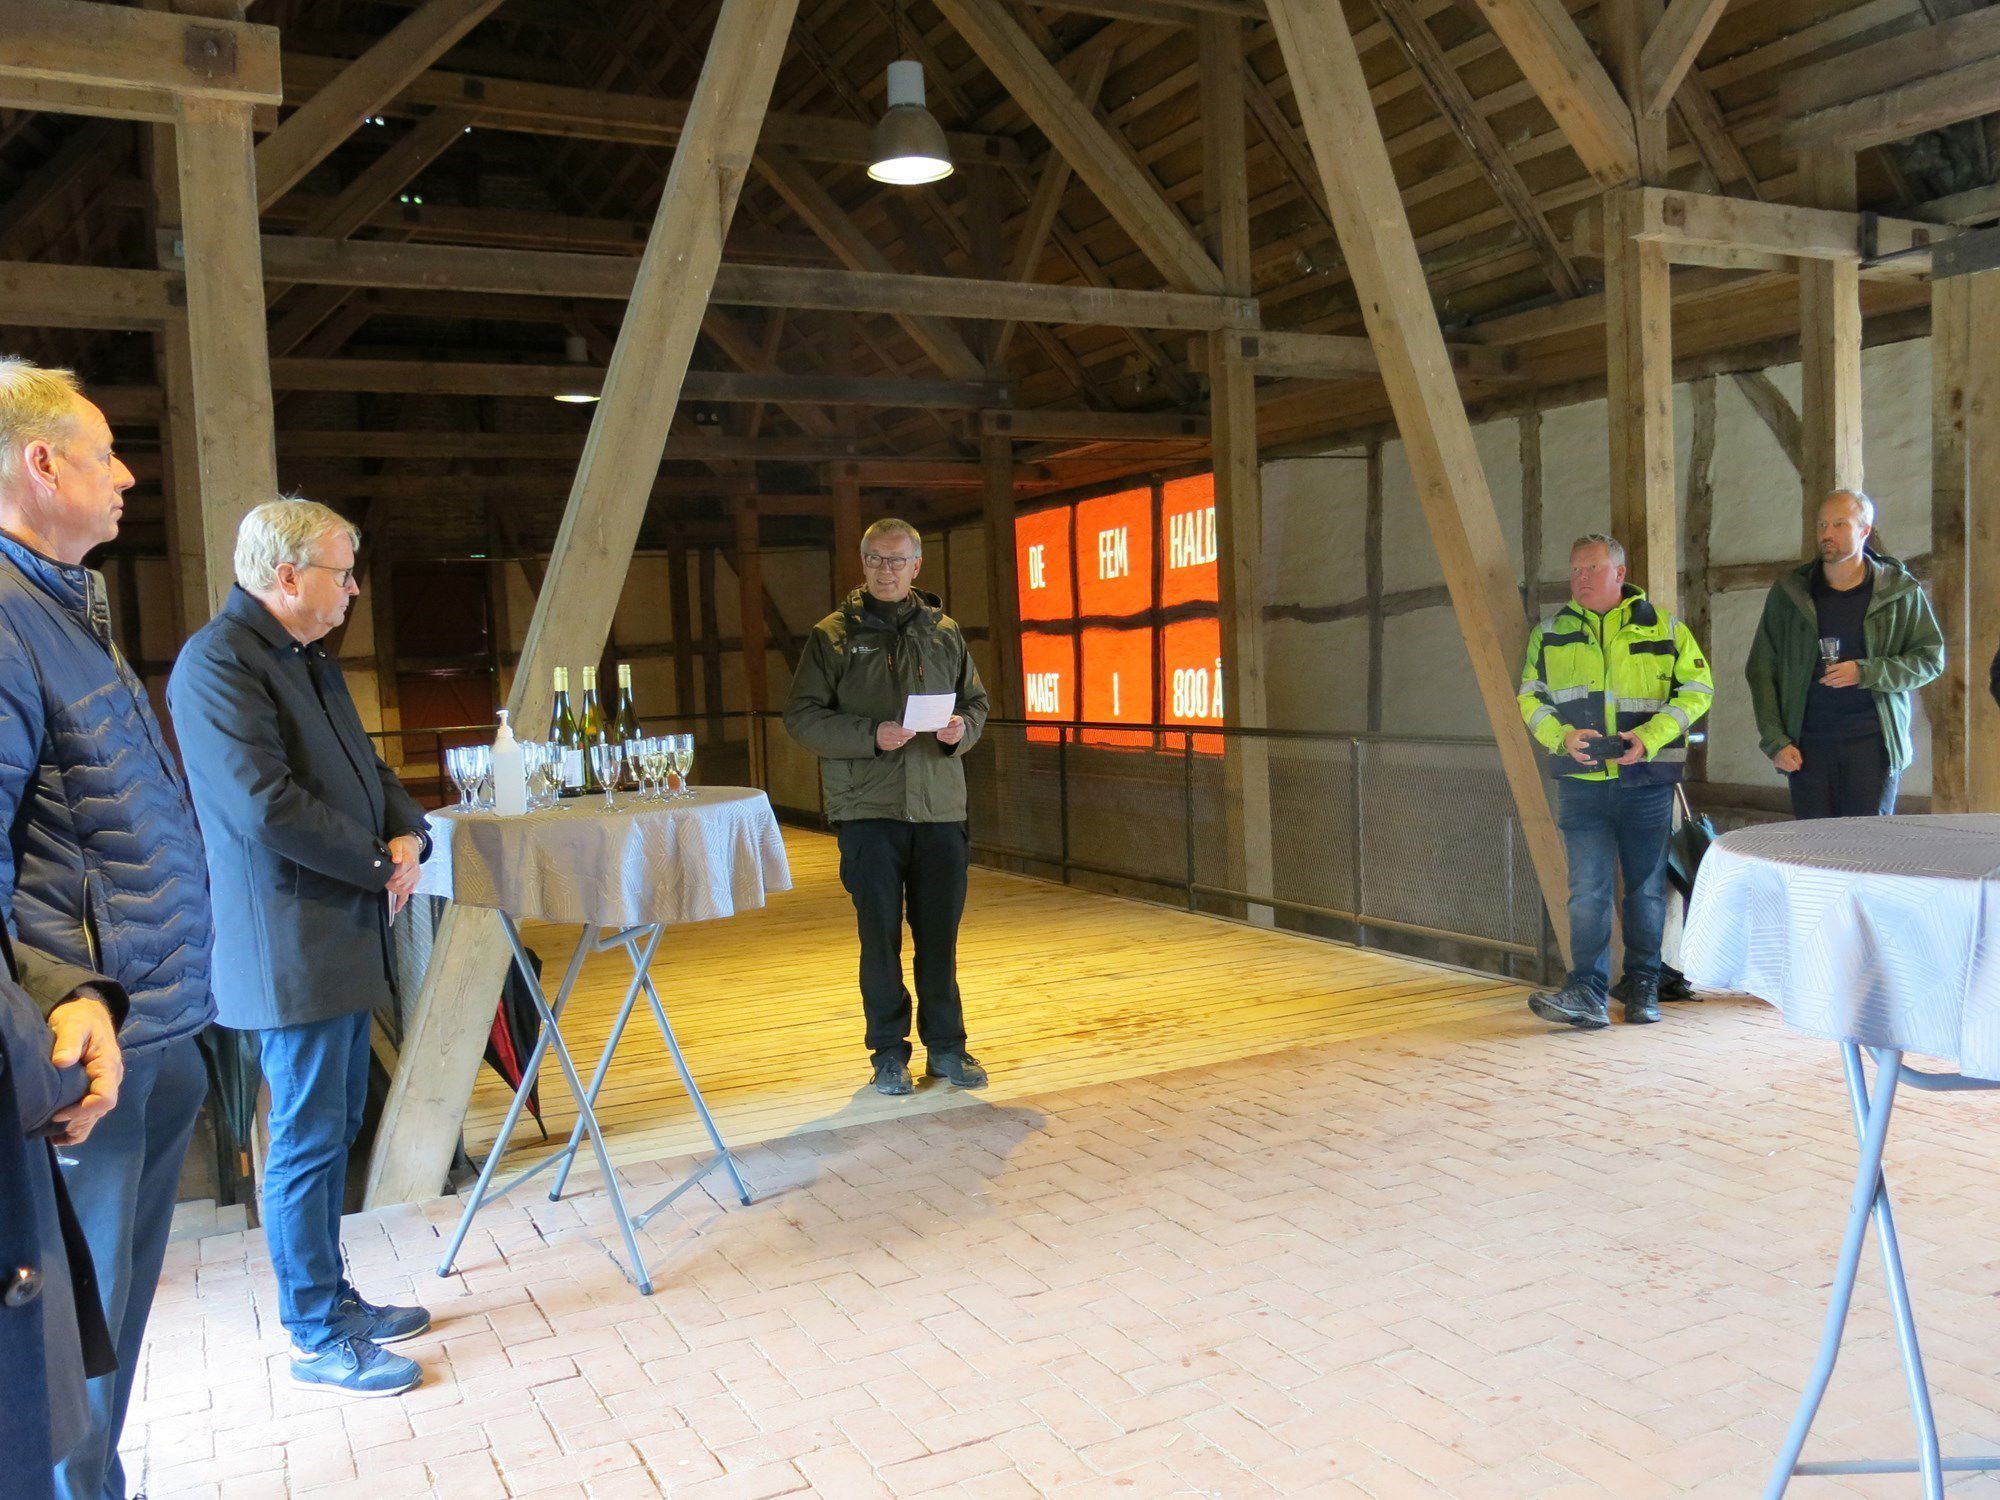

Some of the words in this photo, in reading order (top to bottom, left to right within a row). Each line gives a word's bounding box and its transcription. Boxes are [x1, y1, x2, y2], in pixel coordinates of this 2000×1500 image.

[1028, 544, 1046, 590] DE
[1098, 526, 1129, 580] FEM
[1026, 672, 1060, 713] MAGT
[1113, 672, 1120, 716] I
[1173, 668, 1208, 718] 800
